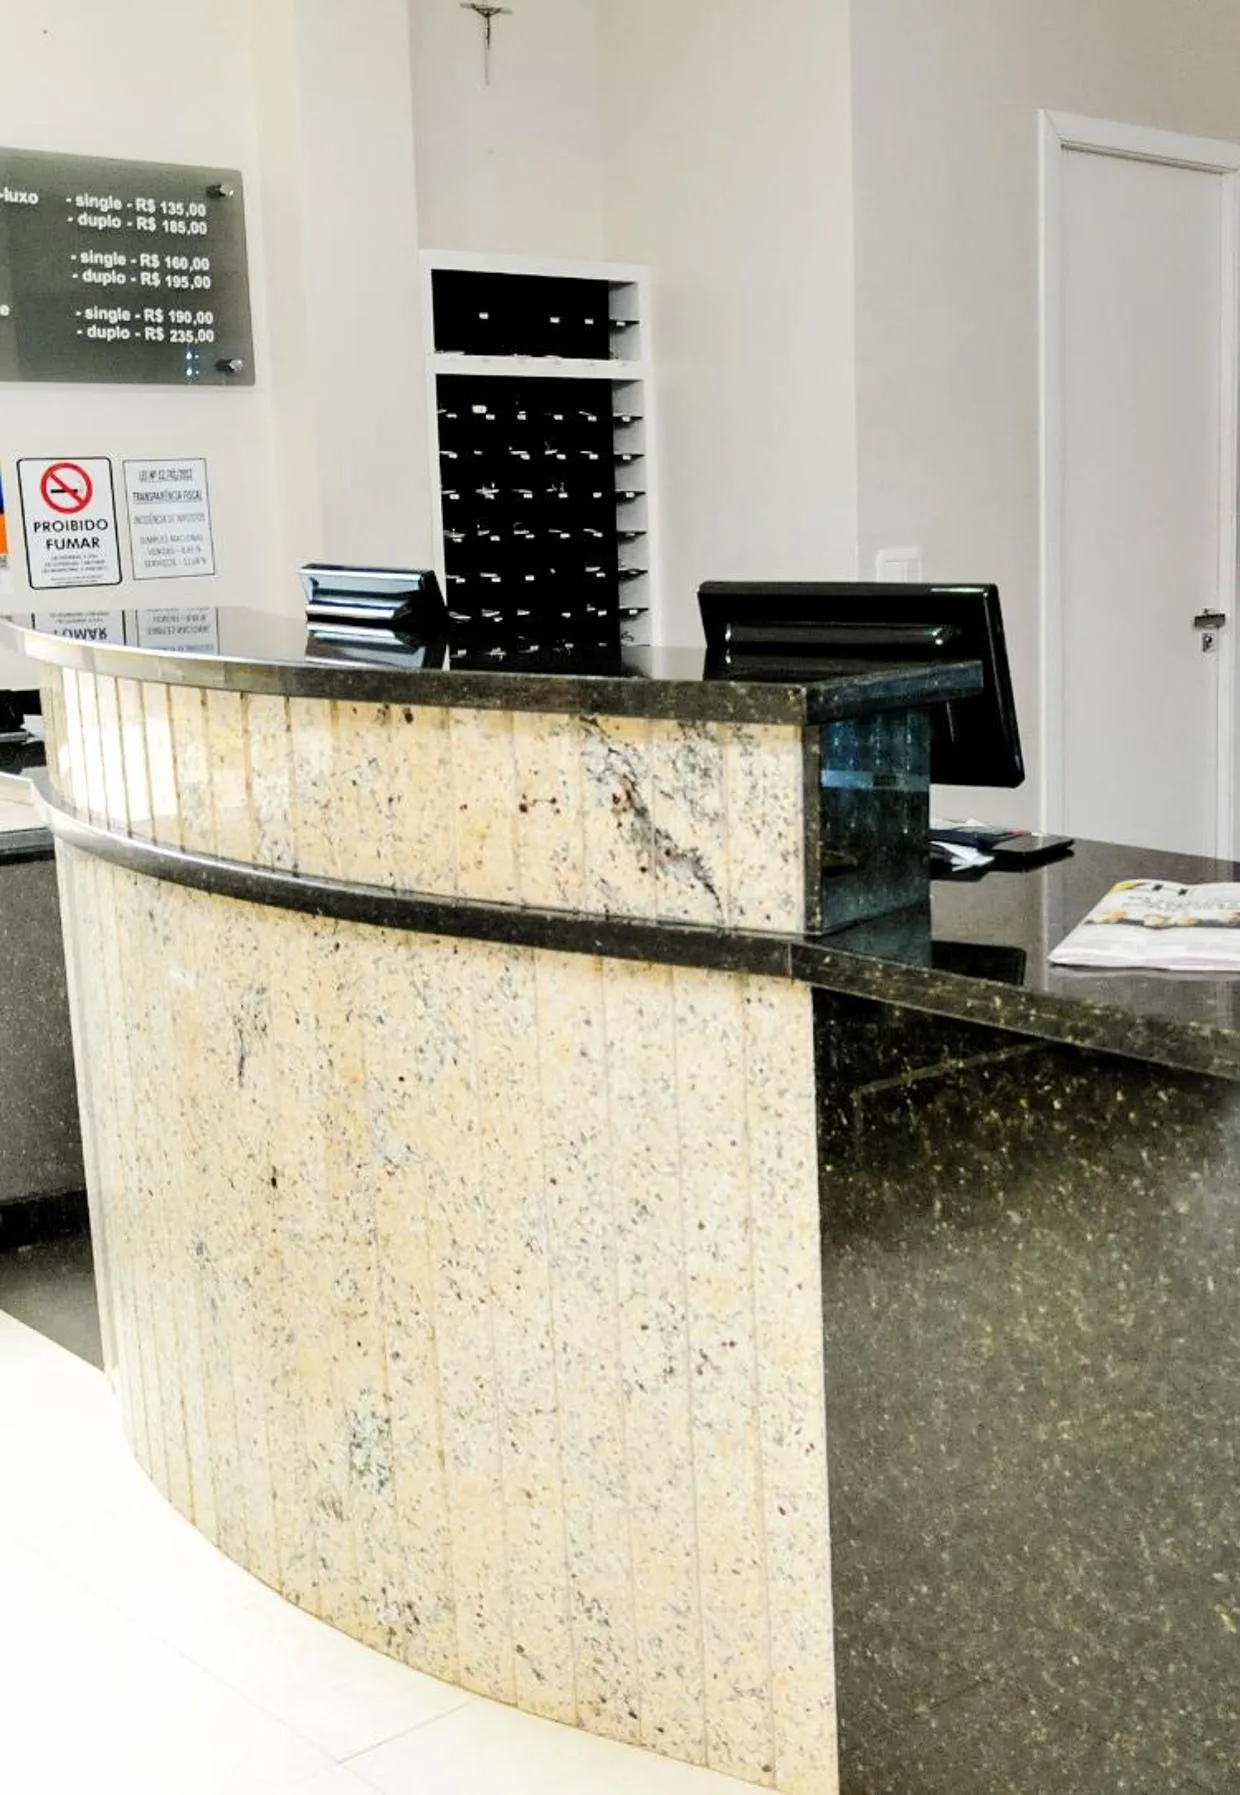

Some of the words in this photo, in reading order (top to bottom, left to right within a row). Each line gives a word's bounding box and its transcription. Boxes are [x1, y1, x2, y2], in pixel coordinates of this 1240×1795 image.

[75, 193, 122, 212] single
[135, 198, 156, 214] R$
[160, 201, 207, 217] 135,00
[78, 212, 122, 230] duplo
[137, 217, 157, 232] R$
[80, 250, 126, 269] single
[140, 254, 160, 269] R$
[82, 269, 126, 286] duplo
[140, 272, 160, 288] R$
[165, 275, 211, 290] 195,00
[85, 306, 131, 324] single
[144, 308, 164, 323] R$
[168, 310, 213, 325] 190,00
[87, 324, 130, 342] duplo
[145, 327, 164, 342] R$
[170, 329, 214, 344] 235,00
[33, 518, 109, 533] PROIBIDO
[46, 536, 100, 552] FUMAR
